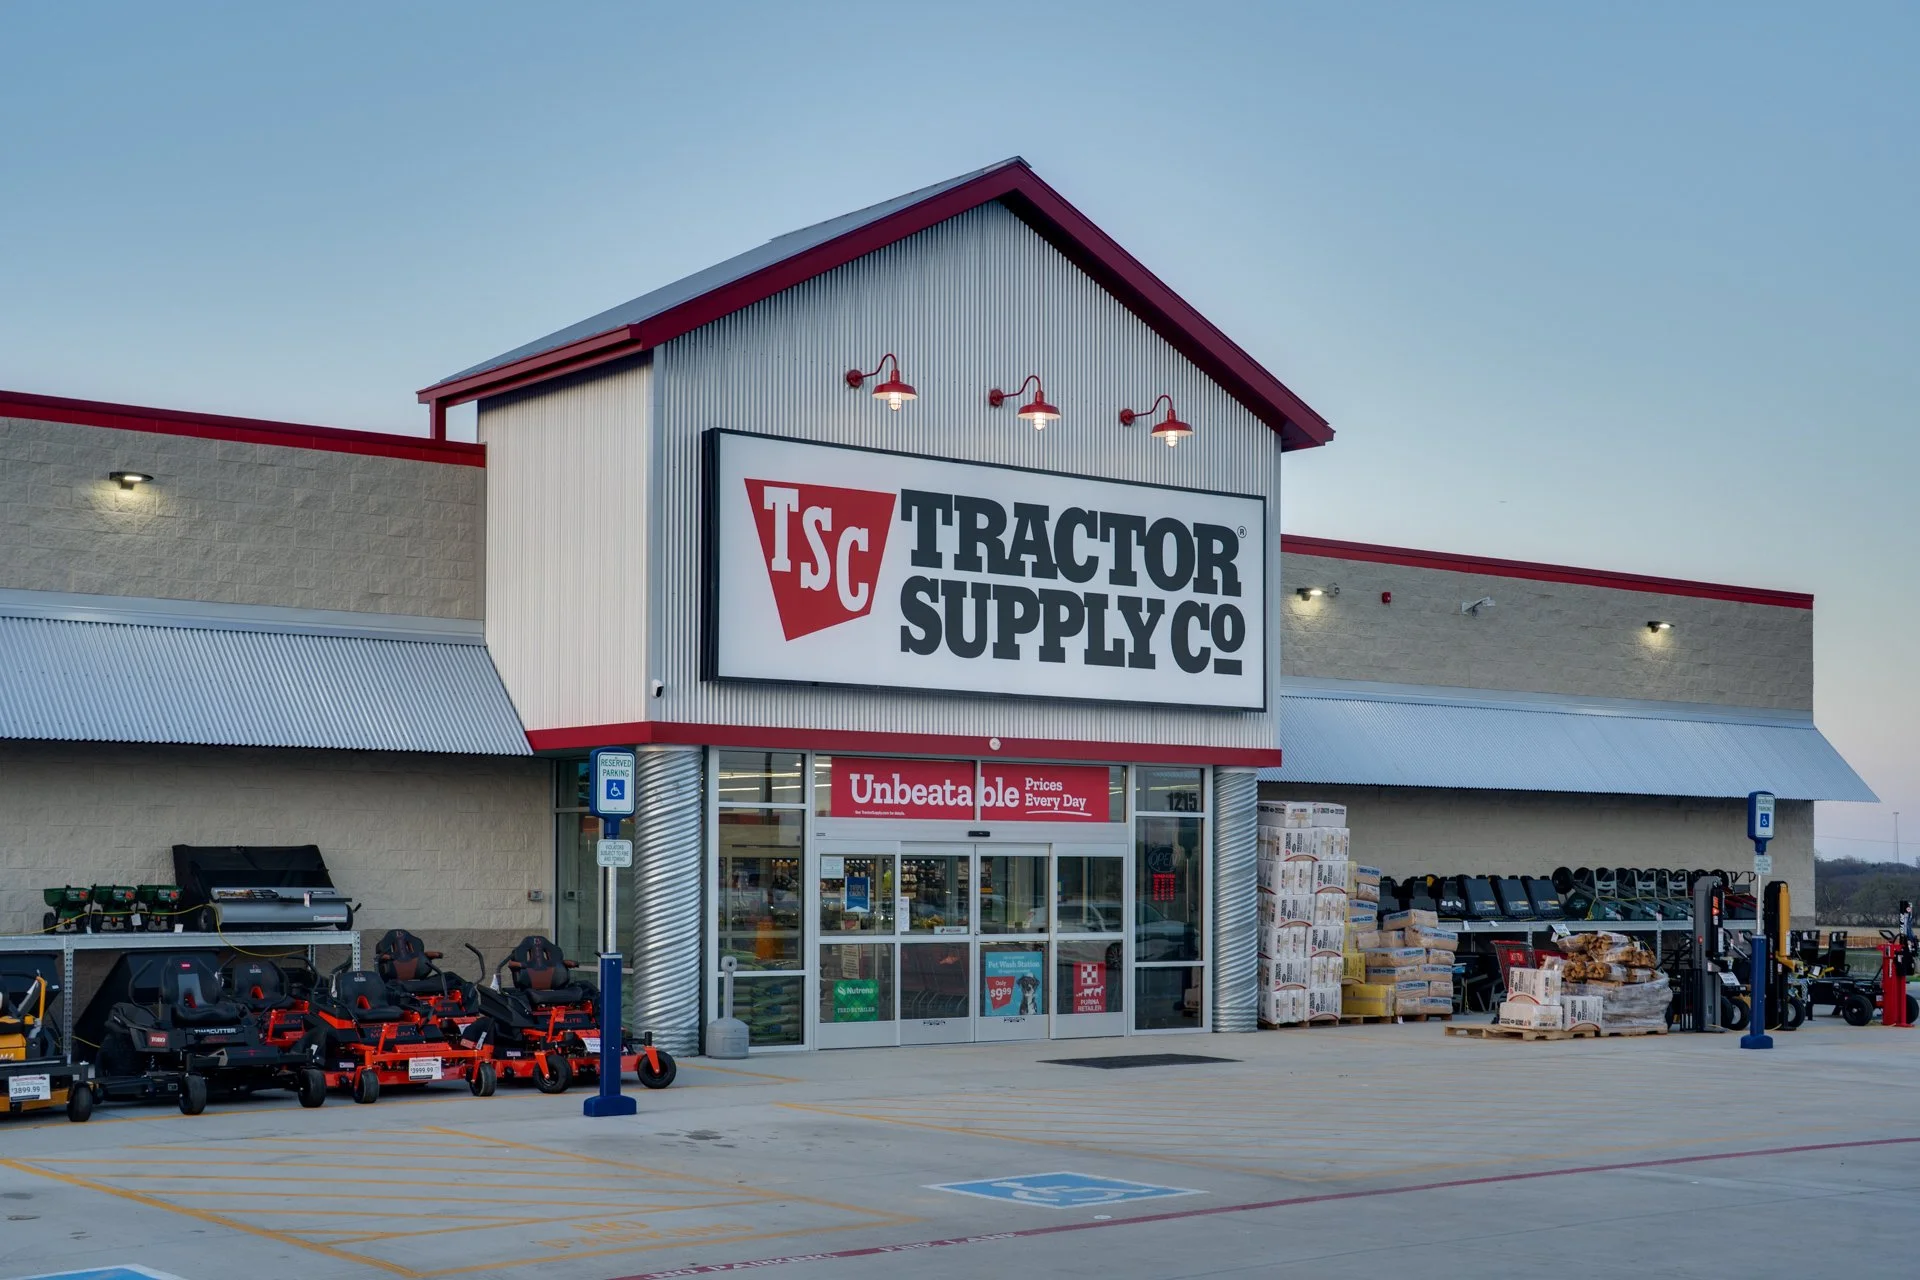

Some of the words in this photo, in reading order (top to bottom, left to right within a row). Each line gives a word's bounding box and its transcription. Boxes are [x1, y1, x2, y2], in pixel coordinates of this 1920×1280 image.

[763, 485, 869, 613] TSC
[900, 575, 1165, 670] SUPPLY
[600, 758, 632, 767] RESERVED
[602, 768, 630, 777] PARKING
[849, 773, 1020, 808] Unbeatable
[1025, 777, 1063, 791] Prices
[1025, 793, 1061, 811] Every
[1062, 794, 1087, 811] Day
[1167, 792, 1198, 811] 1215
[988, 961, 999, 969] Pet
[1017, 960, 1041, 968] Station
[846, 987, 874, 995] Nutrena
